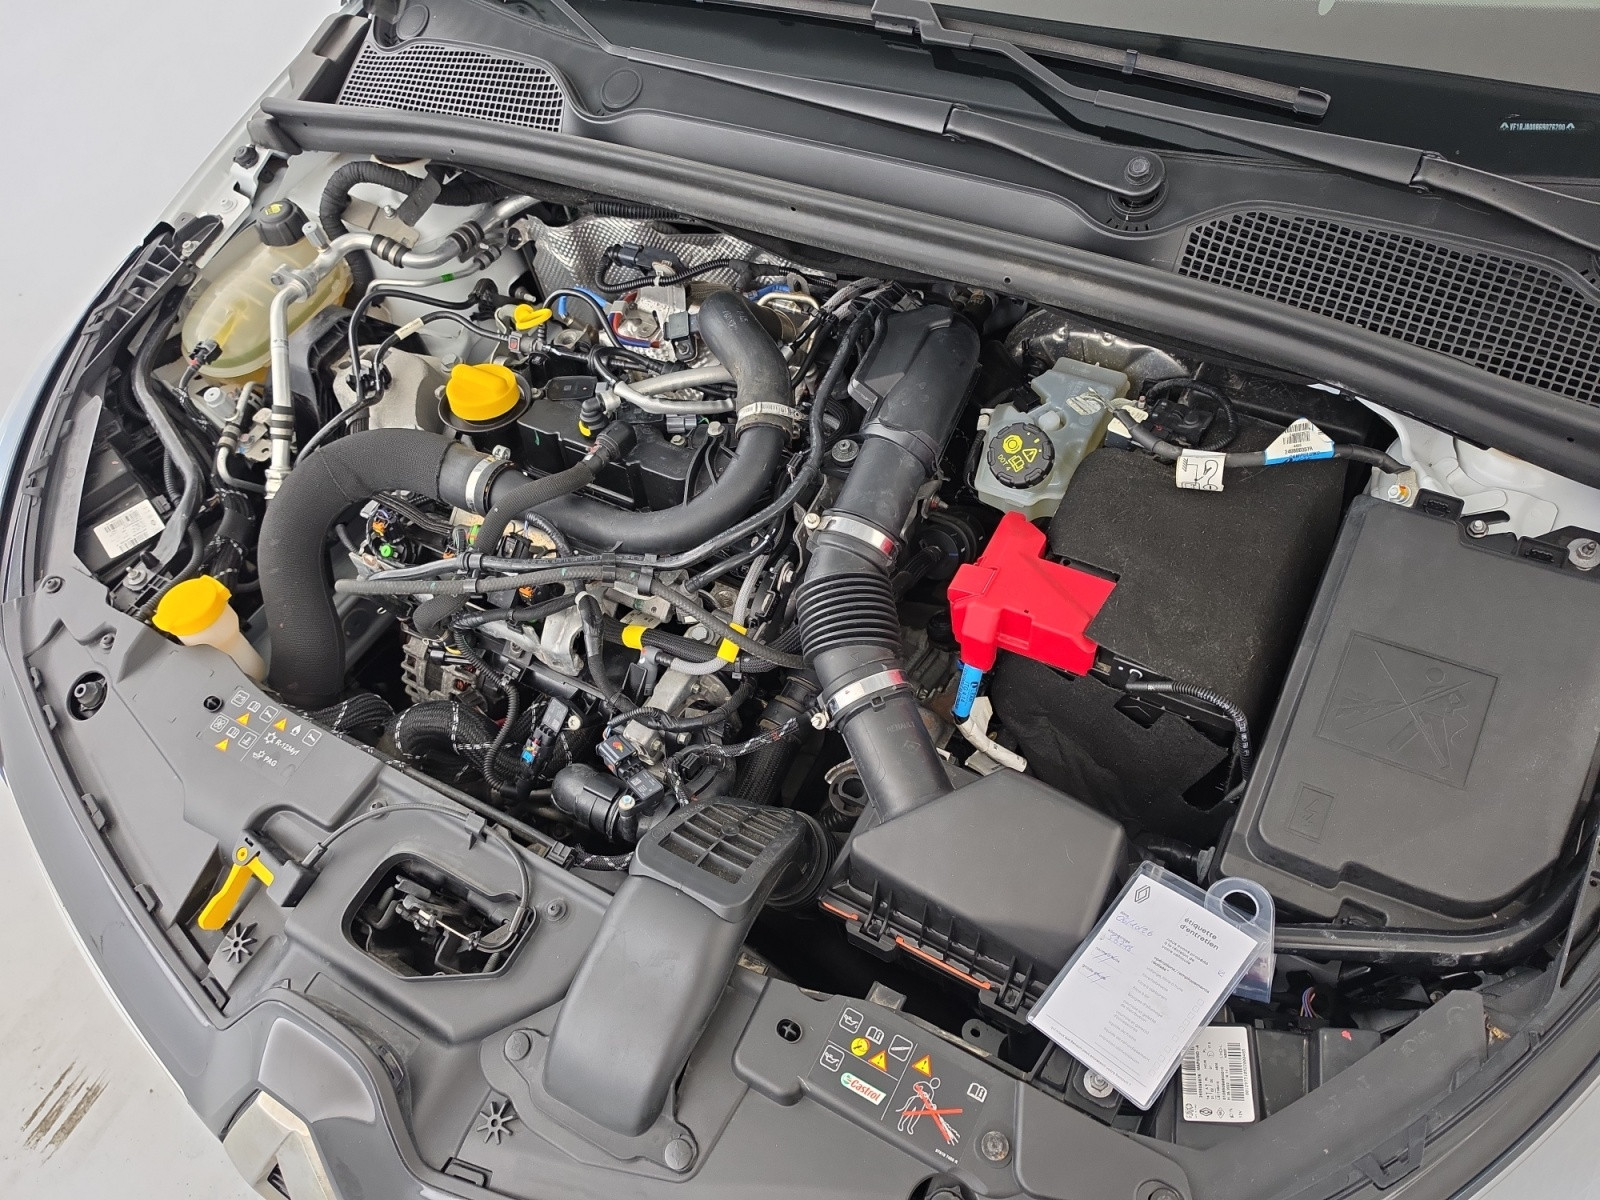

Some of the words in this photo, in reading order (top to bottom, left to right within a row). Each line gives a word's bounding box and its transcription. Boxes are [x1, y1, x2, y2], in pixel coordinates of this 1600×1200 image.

[998, 454, 1009, 466] DOT
[263, 755, 278, 767] PAG
[1180, 924, 1219, 950] d'entretien
[1184, 918, 1217, 940] étiquette
[851, 1079, 882, 1102] Castrol
